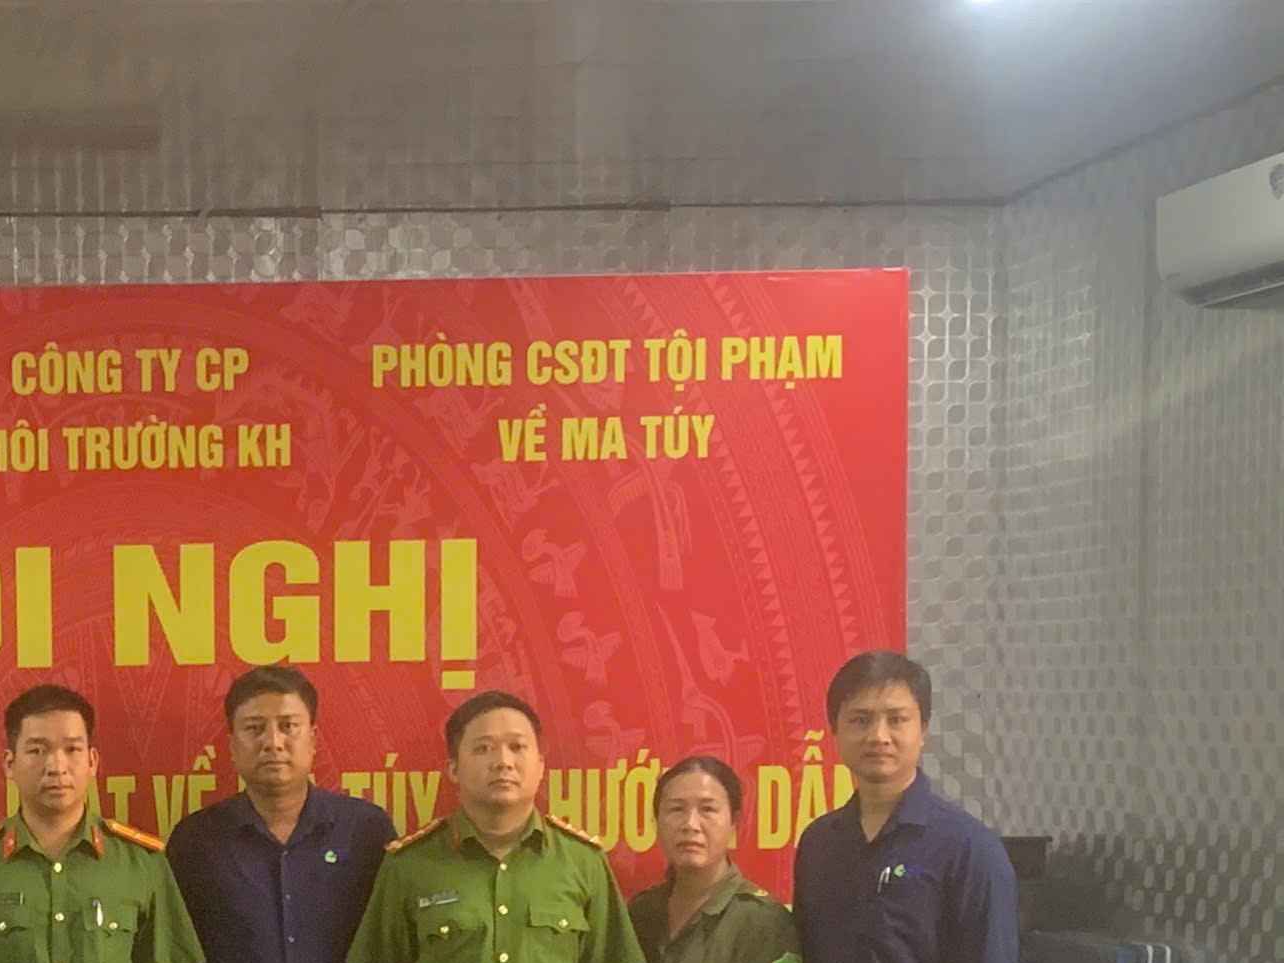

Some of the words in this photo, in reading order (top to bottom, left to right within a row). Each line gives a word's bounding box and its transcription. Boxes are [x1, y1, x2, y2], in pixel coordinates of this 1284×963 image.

[13, 341, 124, 396] CÔNG
[136, 350, 182, 393] TY
[198, 349, 250, 392] CP
[373, 333, 513, 390] PHÒNG
[527, 340, 632, 386] CSĐT
[644, 329, 708, 393] TỘI
[721, 335, 844, 390] PHẠM
[63, 414, 225, 471] TRƯỜNG
[239, 424, 292, 469] KH
[499, 403, 548, 464] VỀ
[562, 417, 628, 462] MA
[640, 407, 717, 460] TÚY
[113, 538, 480, 692] NGHỊ
[548, 748, 737, 853] HƯỚ
